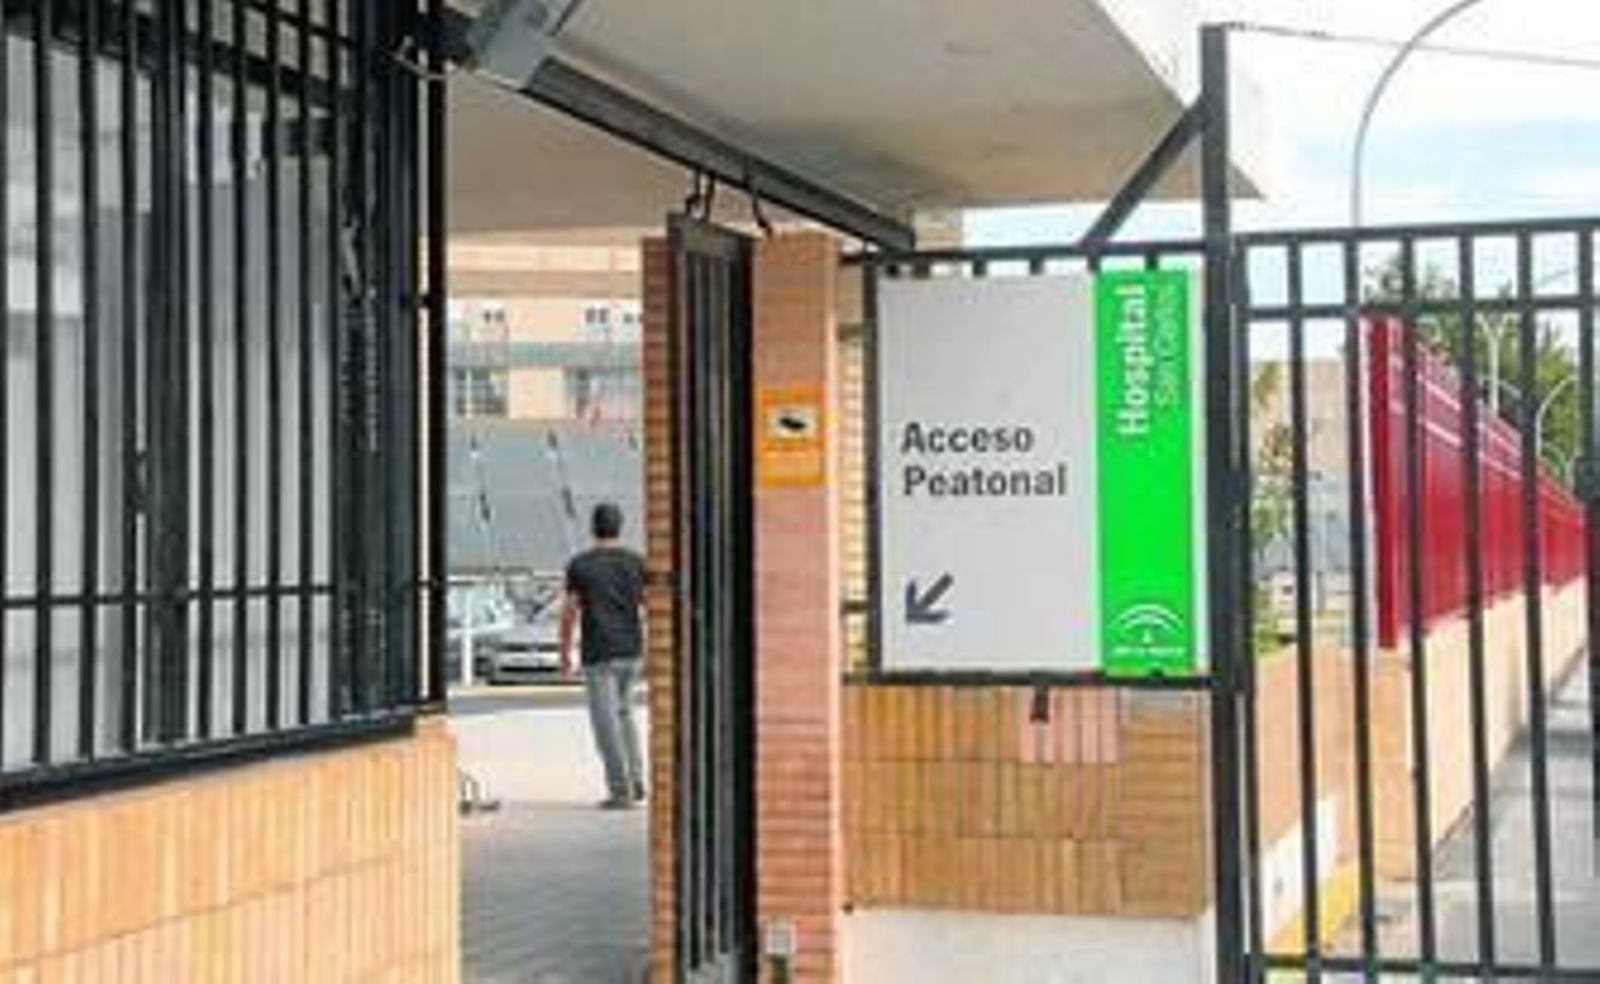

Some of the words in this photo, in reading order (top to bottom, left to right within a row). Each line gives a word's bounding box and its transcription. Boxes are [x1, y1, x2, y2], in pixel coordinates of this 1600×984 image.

[1116, 284, 1153, 435] Hospital
[901, 422, 1034, 453] Acceso
[904, 465, 1067, 497] Peatonal
